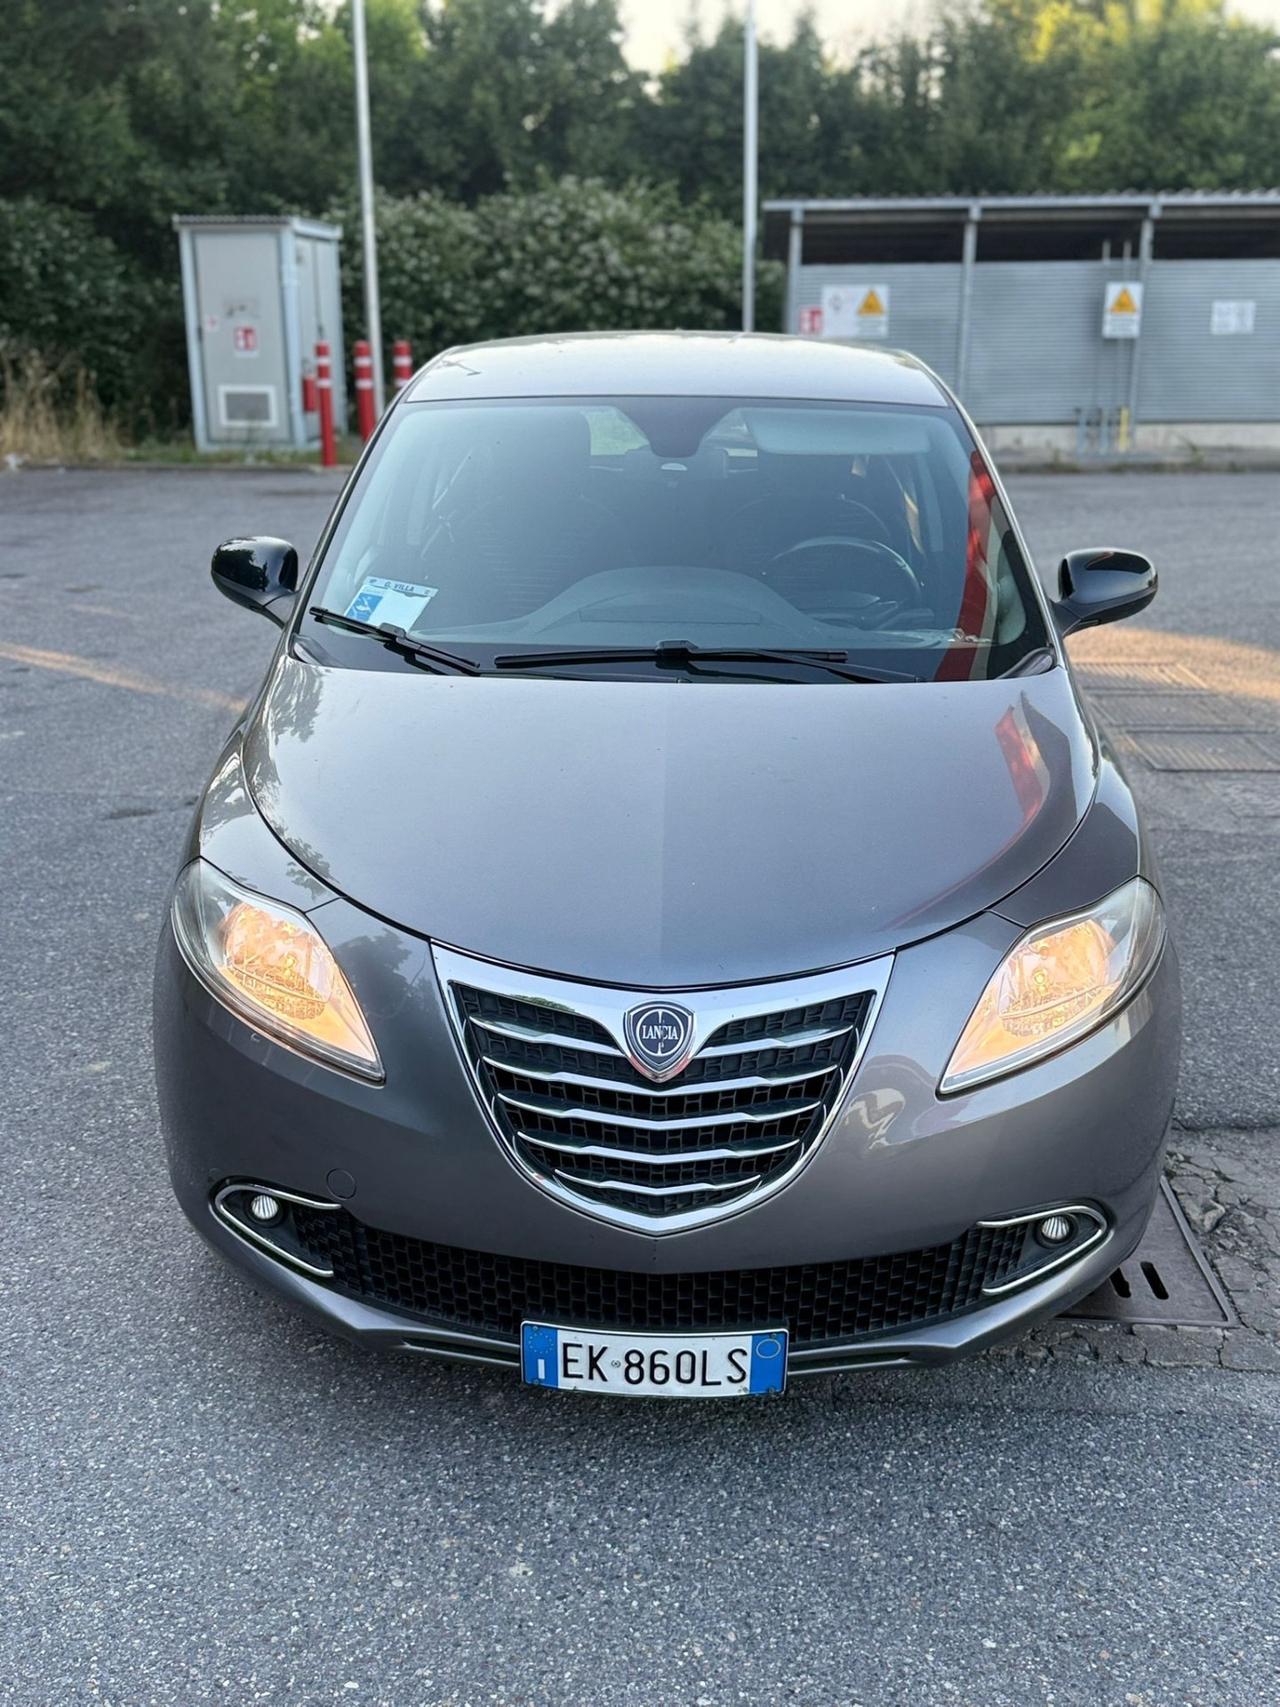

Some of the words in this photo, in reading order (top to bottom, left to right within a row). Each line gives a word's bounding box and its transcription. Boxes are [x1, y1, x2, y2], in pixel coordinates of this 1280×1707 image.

[642, 1025, 679, 1040] LANCIA
[537, 1358, 545, 1379] I
[562, 1342, 608, 1382] EK
